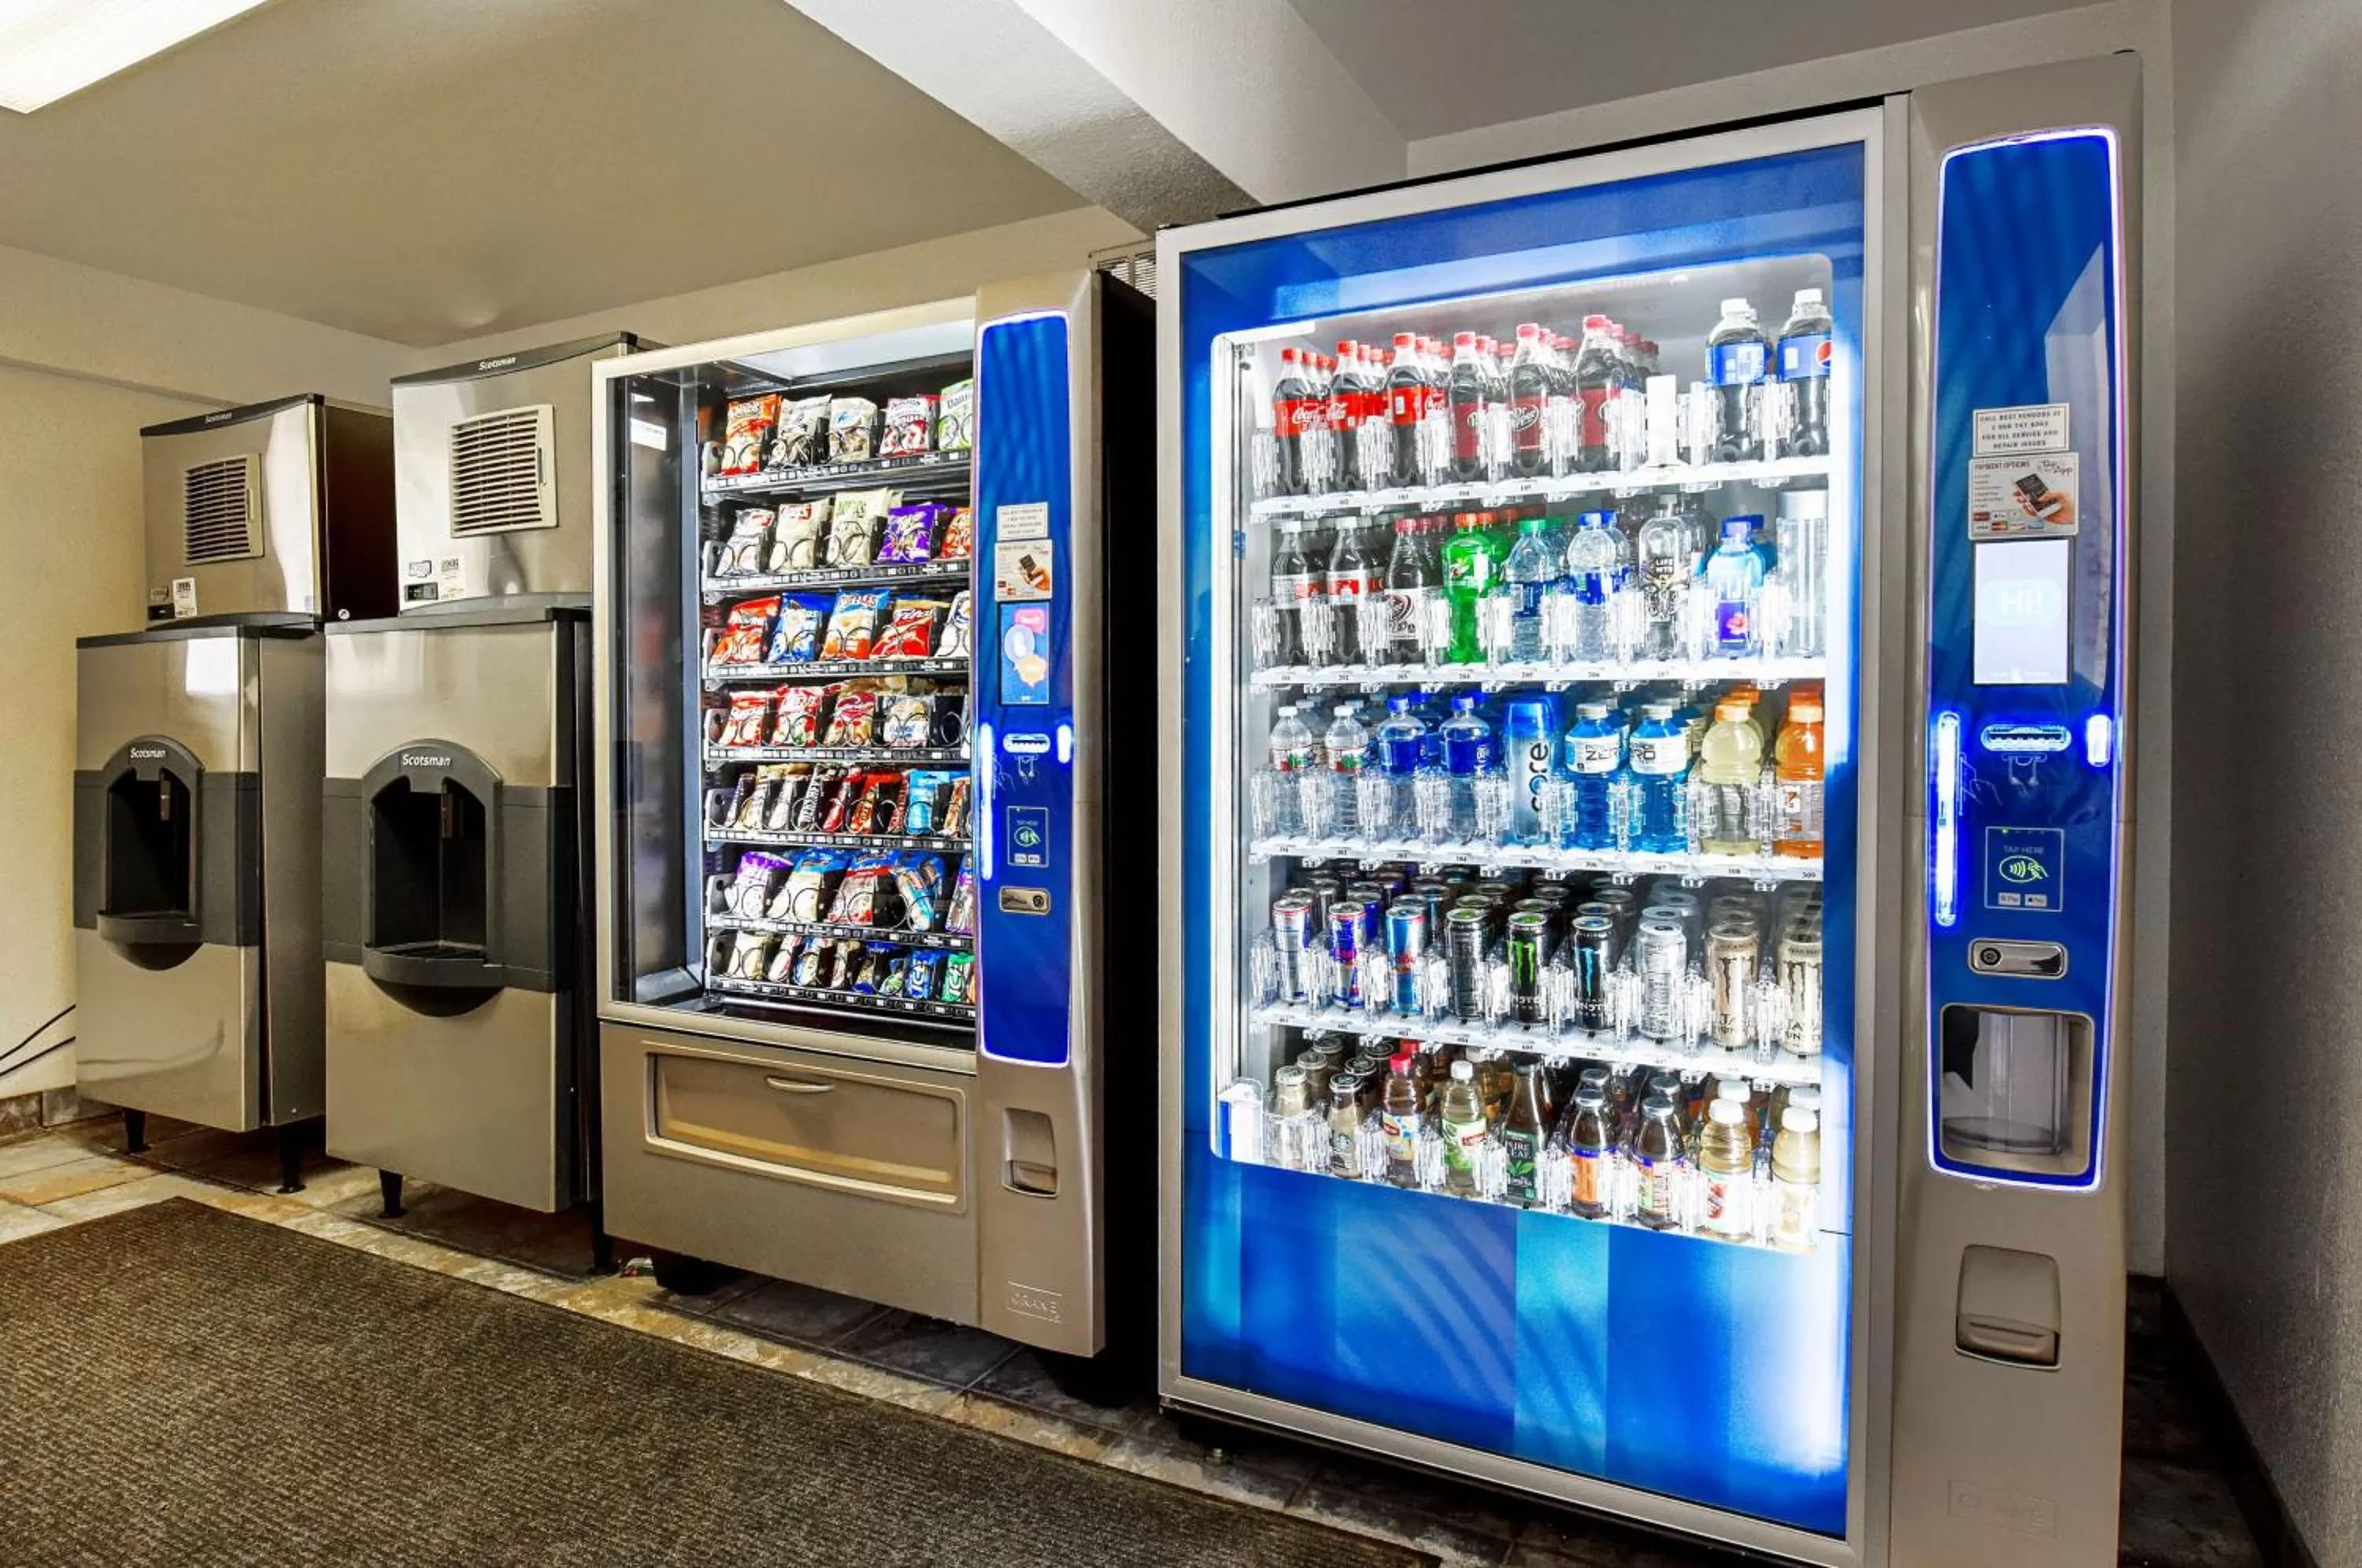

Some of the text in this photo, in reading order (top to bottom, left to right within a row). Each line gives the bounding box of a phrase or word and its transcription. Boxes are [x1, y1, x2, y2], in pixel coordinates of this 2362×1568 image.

[478, 357, 516, 371] Scotsman
[1975, 460, 2030, 471] PAYMENT OPTIONS
[130, 747, 166, 759] Scotsman
[402, 753, 451, 767] Scotsman
[1528, 741, 1549, 813] core
